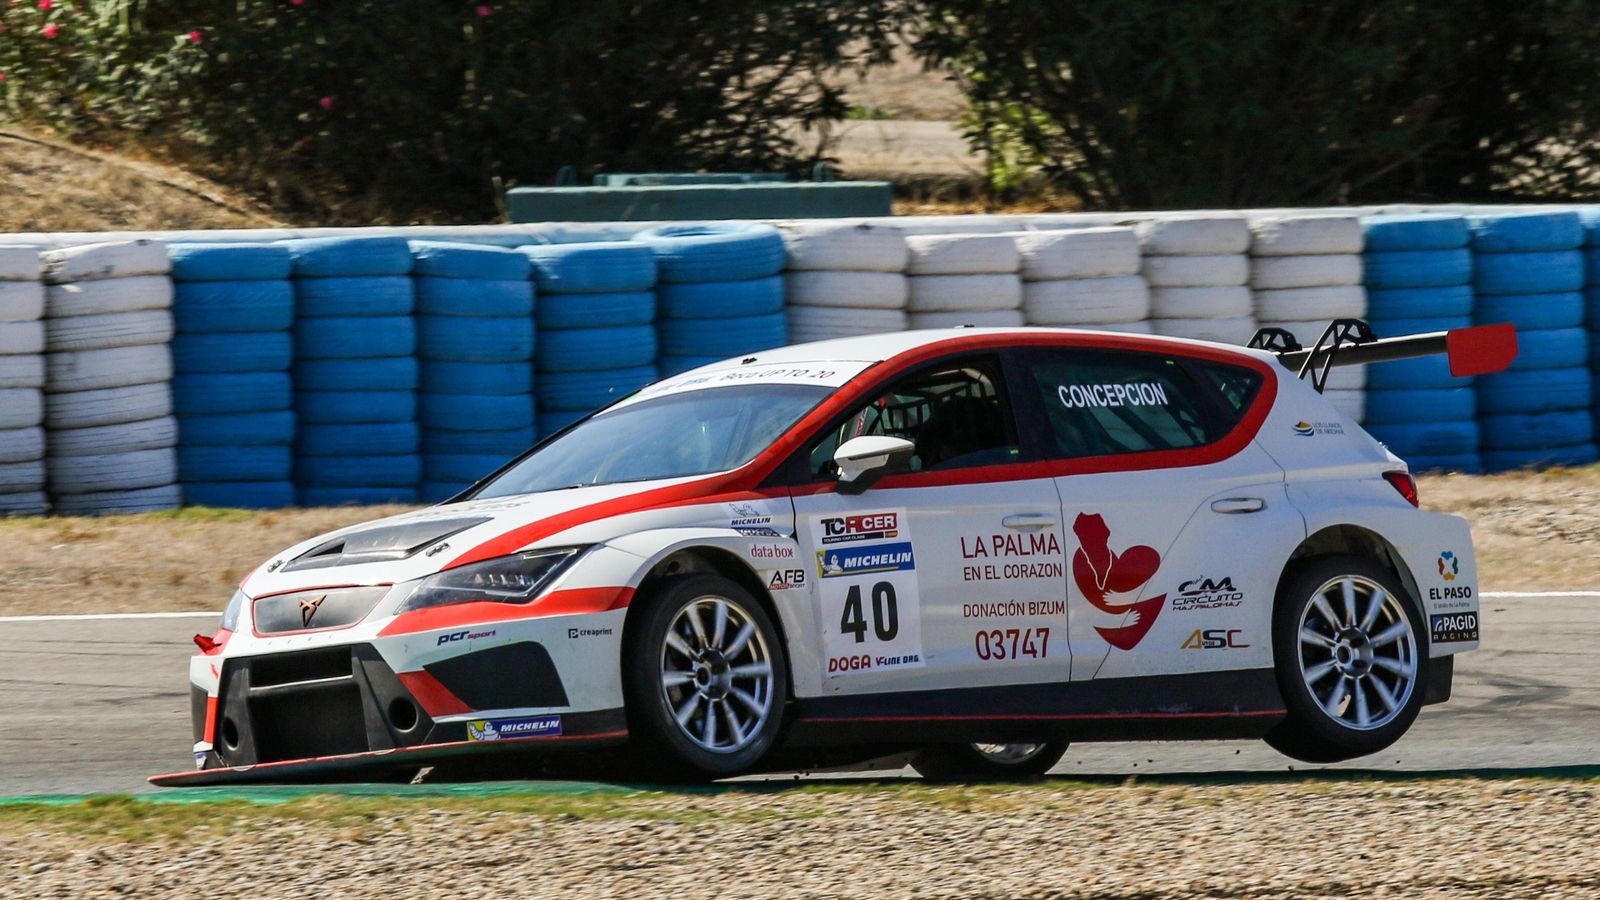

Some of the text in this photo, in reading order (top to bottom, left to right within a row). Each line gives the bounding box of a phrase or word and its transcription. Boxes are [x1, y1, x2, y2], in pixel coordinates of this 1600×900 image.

[1058, 383, 1168, 408] CONCEPCION
[731, 517, 771, 526] MICHELIN
[862, 515, 895, 530] CER
[751, 544, 794, 558] data box
[960, 533, 1061, 559] LA PALMA
[844, 552, 912, 568] MICHELIN
[770, 569, 805, 584] AFB
[963, 563, 1062, 581] EN EL CORAZON
[1172, 592, 1243, 606] CIRCUITO
[1429, 586, 1472, 600] EL PASO
[841, 581, 899, 643] 40
[963, 600, 1065, 617] DONACIÓN BIZUM
[1443, 615, 1476, 631] PAGID
[580, 628, 612, 637] creaprint
[1180, 628, 1250, 650] ASC
[1433, 631, 1477, 640] RACING
[975, 627, 1050, 661] 03747
[828, 654, 871, 673] DOGA
[500, 720, 559, 733] MICHELIN
